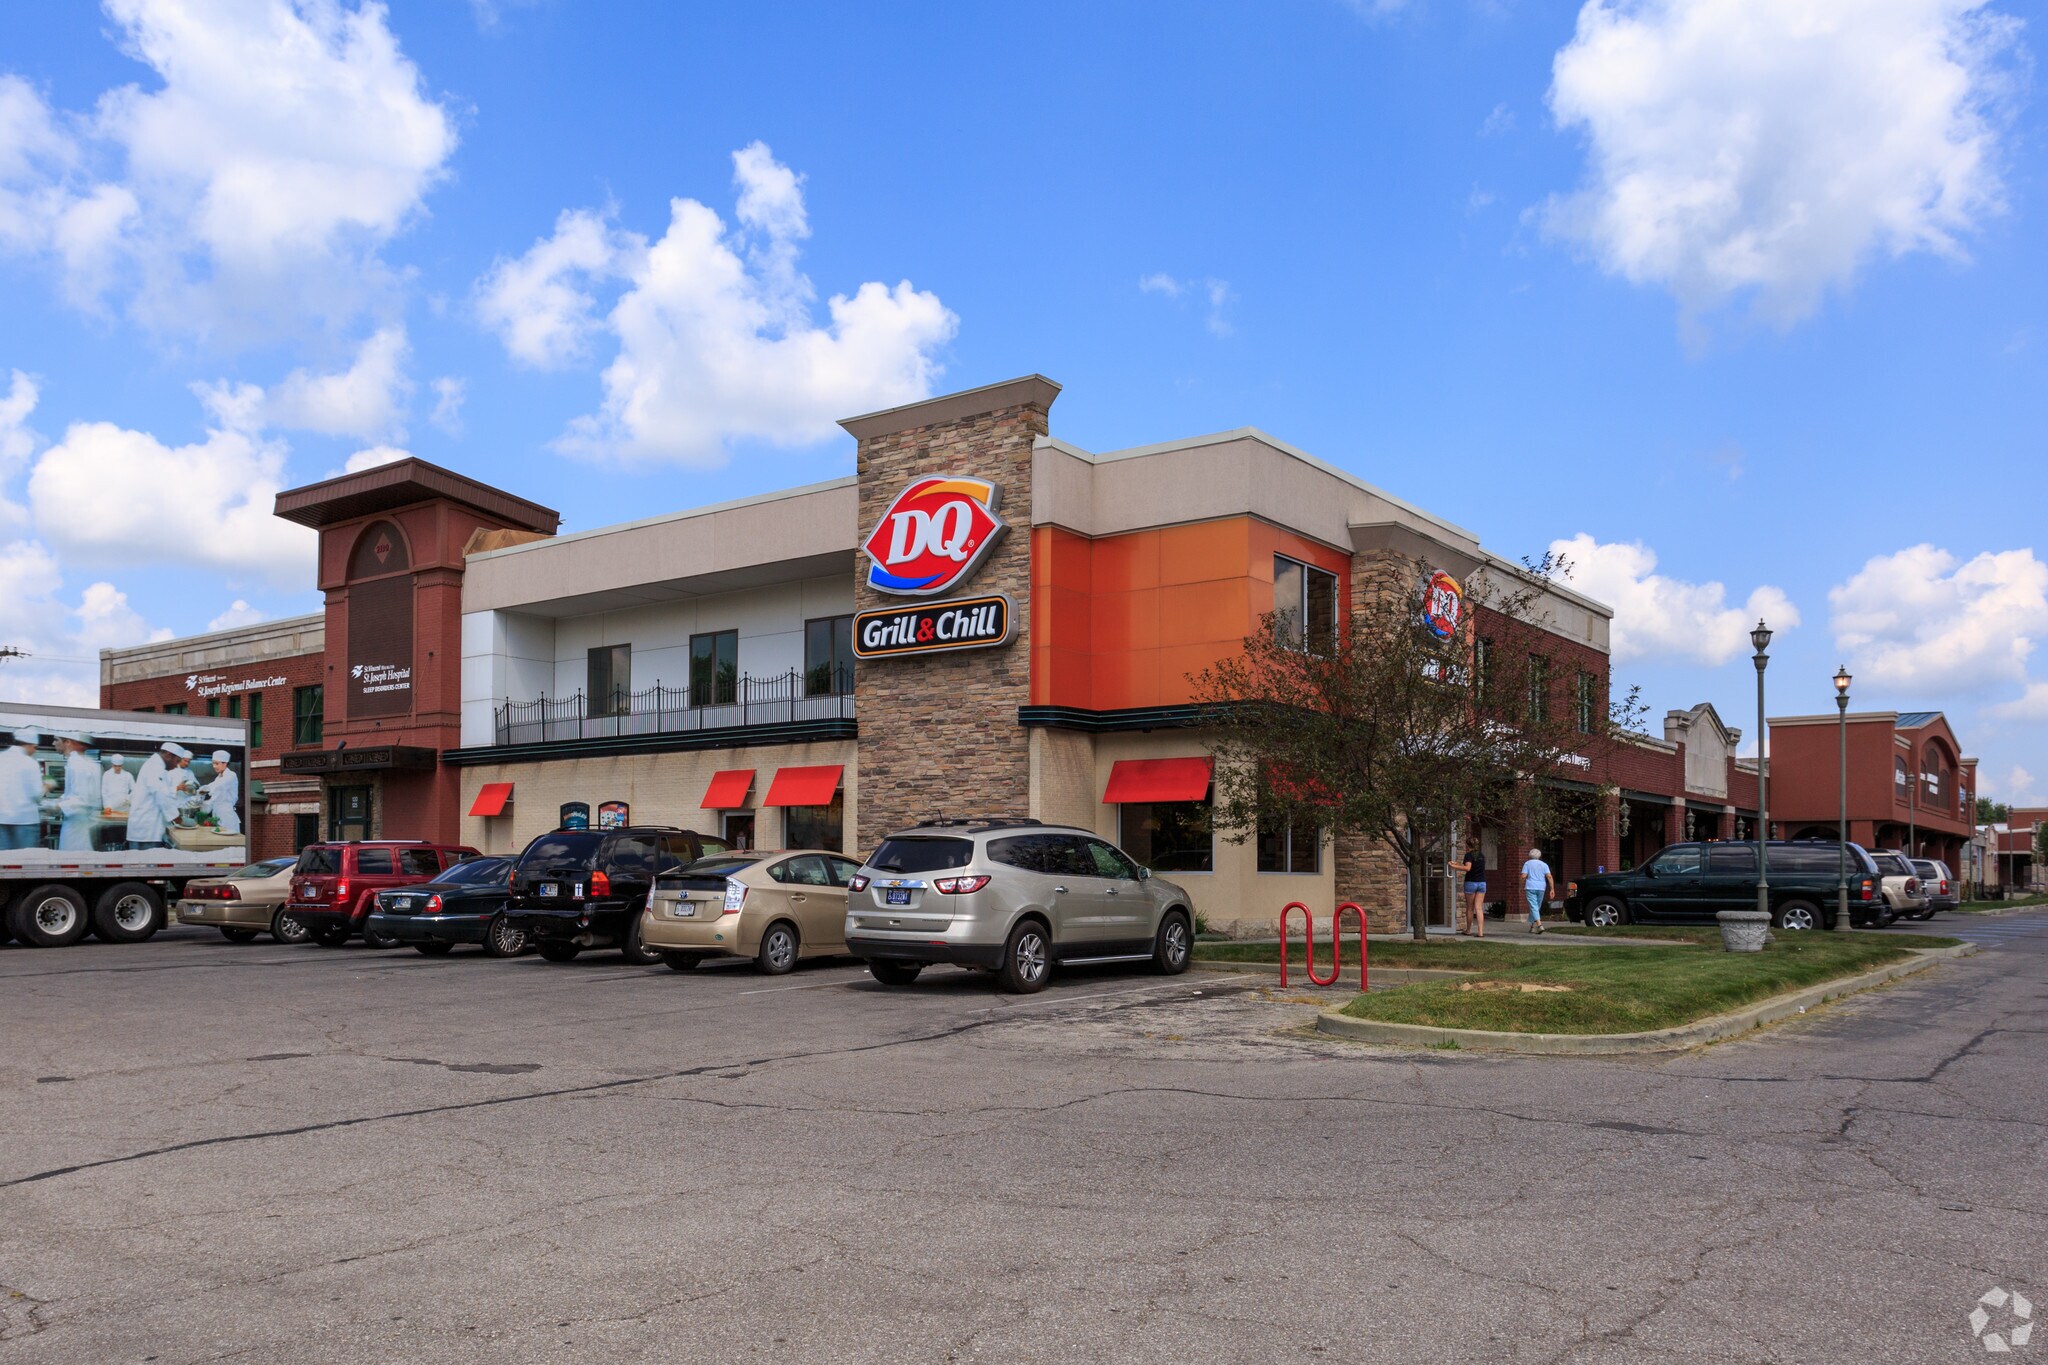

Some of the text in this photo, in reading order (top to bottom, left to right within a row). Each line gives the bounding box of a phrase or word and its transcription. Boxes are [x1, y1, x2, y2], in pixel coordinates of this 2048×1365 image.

[885, 500, 973, 563] DQ
[388, 667, 411, 682] Hospital
[221, 681, 245, 695] Regional
[245, 678, 268, 690] Balance
[268, 676, 287, 687] Center
